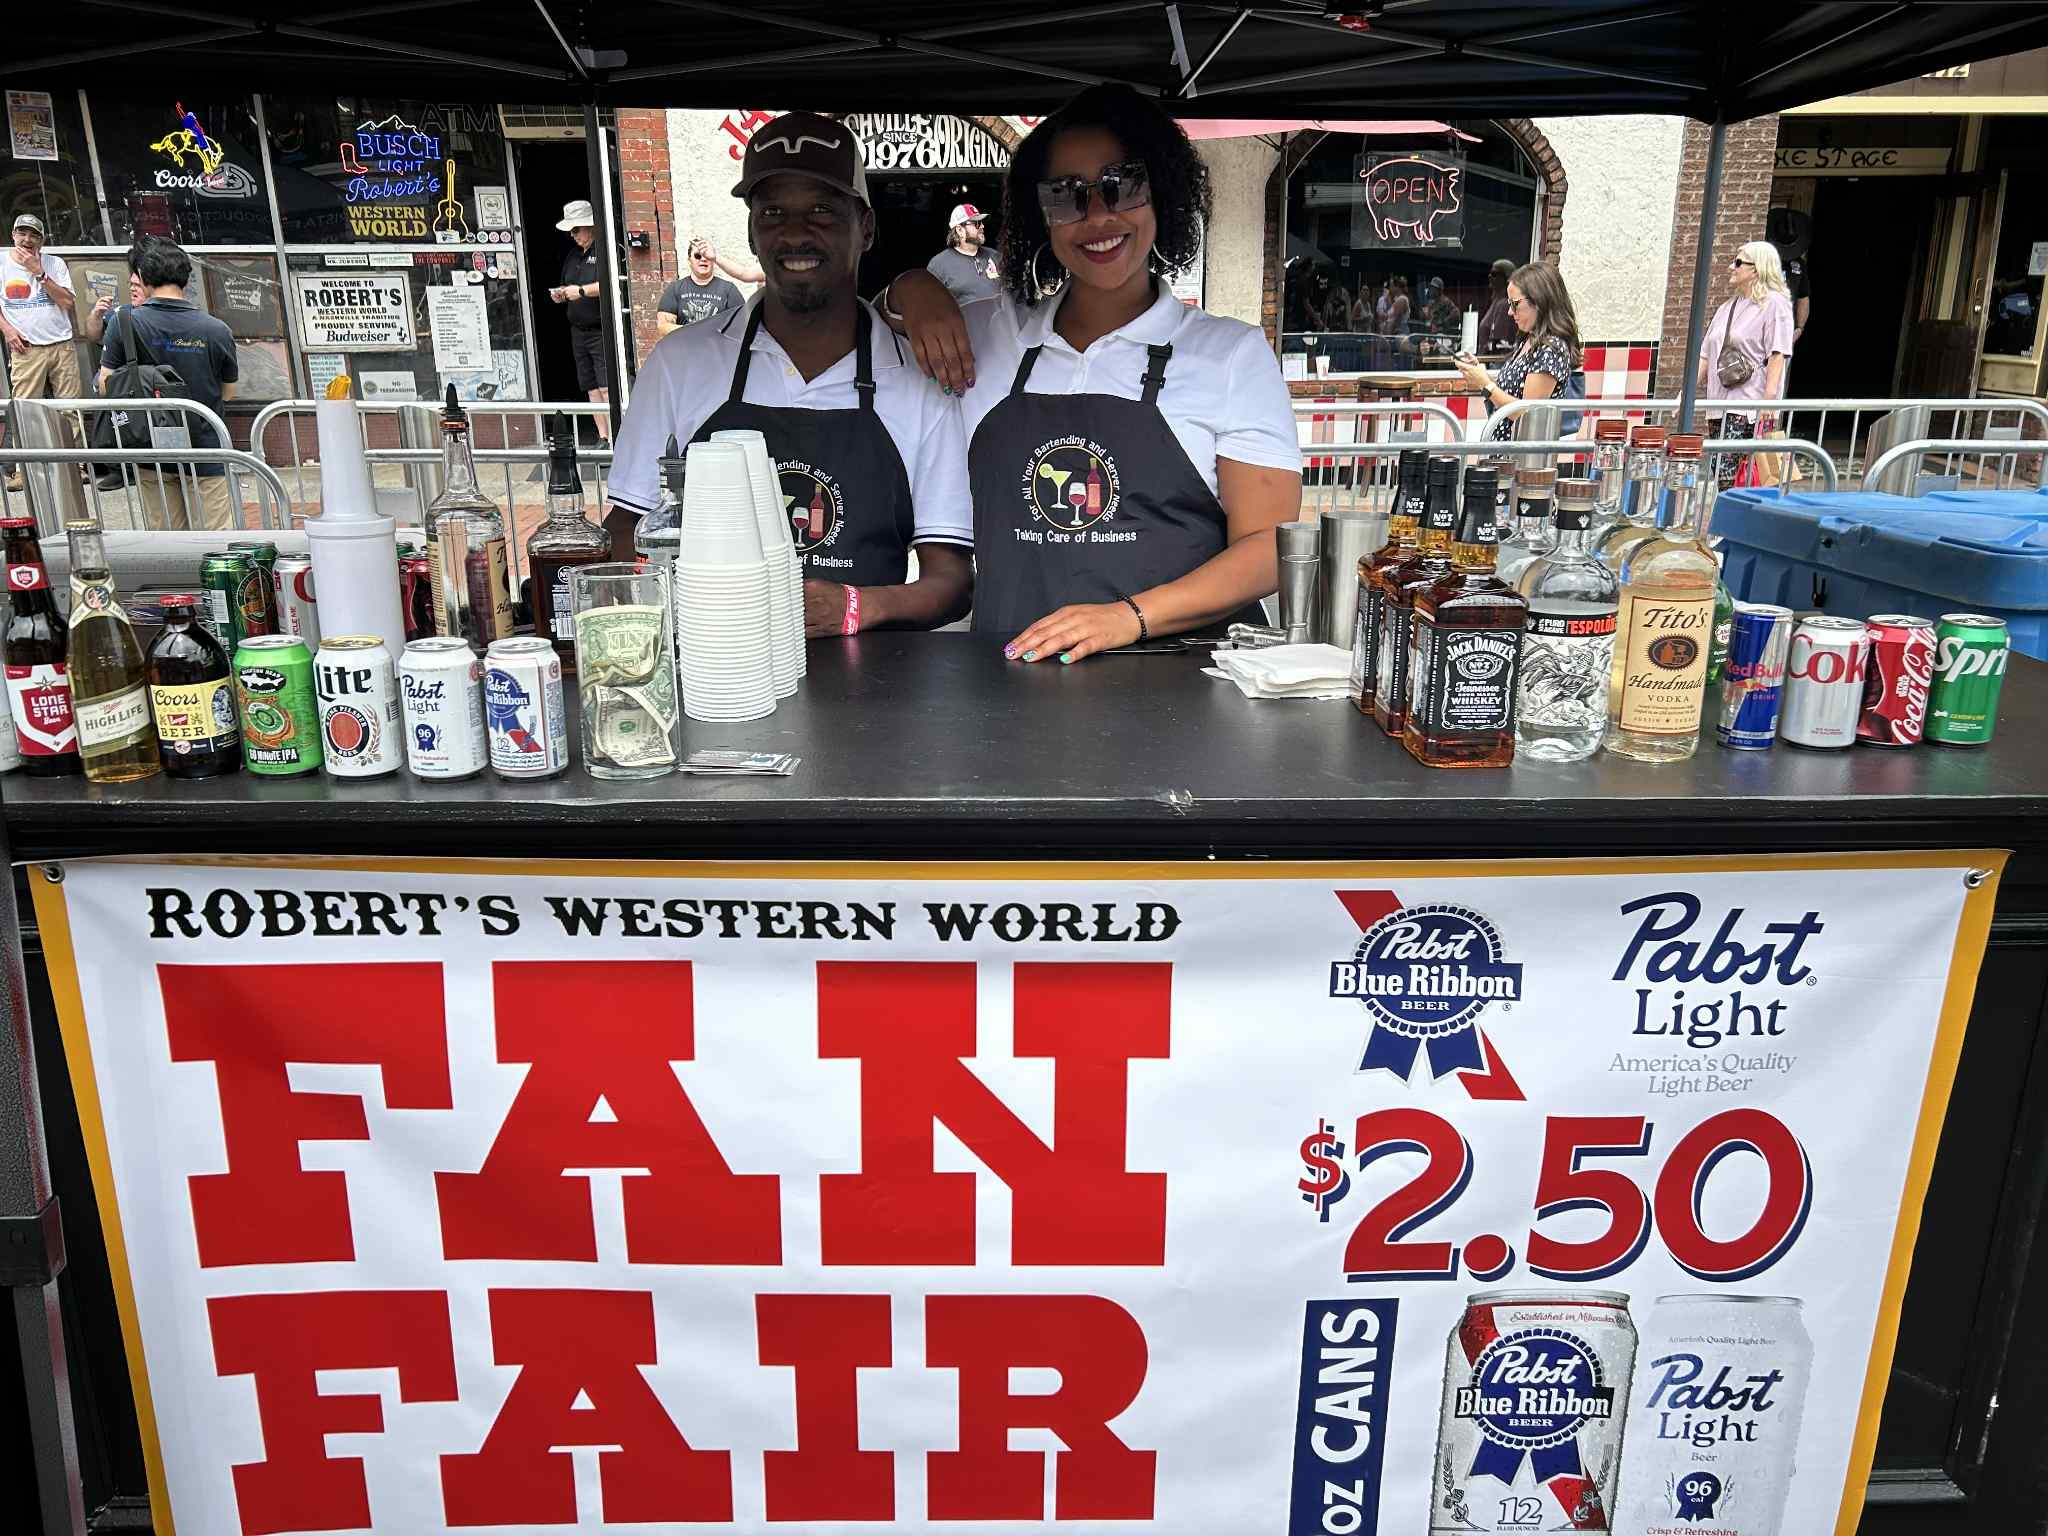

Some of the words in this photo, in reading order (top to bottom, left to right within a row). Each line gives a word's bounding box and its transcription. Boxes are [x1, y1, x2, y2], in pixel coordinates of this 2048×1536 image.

[418, 103, 497, 133] ATM
[357, 133, 441, 160] BUSCH
[882, 131, 918, 143] SINCE
[864, 139, 938, 170] 1976
[1815, 148, 1898, 168] STAGE
[378, 160, 425, 172] LIGHT
[154, 169, 204, 188] Coors
[345, 171, 441, 202] Robert's
[1373, 177, 1444, 204] OPEN
[347, 205, 426, 219] WESTERN
[350, 219, 428, 237] WORLD
[321, 280, 361, 288] WELCOME
[303, 288, 403, 307] ROBERT'S
[317, 307, 357, 315] WESTERN
[359, 306, 387, 314] WORLD
[326, 330, 390, 342] Budweiser
[1034, 435, 1087, 458] Bartending
[1088, 440, 1107, 457] and
[777, 460, 811, 473] ending
[813, 468, 833, 484] and
[1022, 458, 1036, 486] Your
[1105, 456, 1120, 491] Server
[830, 483, 845, 516] Server
[1022, 485, 1033, 500] All
[1028, 504, 1043, 522] For
[1102, 494, 1121, 523] Needs
[824, 519, 845, 548] Needs
[1014, 529, 1043, 544] Taking
[1047, 530, 1071, 543] Care
[1075, 532, 1087, 543] of
[1091, 530, 1137, 543] Business
[812, 554, 853, 568] Business
[1544, 618, 1566, 627] PURO
[1641, 606, 1709, 629] Tito's
[1446, 640, 1474, 661] JACK
[1474, 636, 1516, 661] DANIEL'S
[1788, 633, 1867, 684] Cok
[1727, 657, 1753, 677] Red
[1754, 662, 1783, 678] Bull
[1933, 636, 2011, 683] Spri
[315, 663, 373, 702] Lite
[402, 674, 446, 699] Pabst
[486, 675, 511, 693] Pabst
[1455, 681, 1500, 693] Tennessee
[31, 694, 65, 707] LONE
[153, 689, 200, 706] Coors
[407, 699, 441, 715] Light
[494, 693, 529, 706] Ribbon
[1450, 696, 1503, 705] WHISKEY
[1647, 695, 1690, 703] VODKA
[33, 704, 70, 718] STAR
[85, 714, 116, 731] HIGH
[119, 703, 143, 721] LIFE
[339, 706, 368, 728] PILSNER
[160, 727, 206, 737] BEER
[417, 728, 432, 738] 96
[281, 748, 298, 760] IPA
[145, 887, 521, 939] ROBERT'S
[544, 897, 896, 941] WESTERN
[923, 902, 1183, 942] WORLD
[1379, 921, 1478, 961] Pabst
[1611, 891, 1825, 986] Pabst
[1333, 963, 1404, 996] Blue
[1407, 964, 1516, 998] Ribbon
[1401, 1000, 1450, 1011] BEER
[1632, 988, 1788, 1049] Light
[1608, 1053, 1718, 1073] America's
[1720, 1052, 1798, 1074] Quality
[1648, 1075, 1702, 1097] Light
[1704, 1075, 1753, 1093] Beer
[156, 960, 1173, 1269] FAN
[1298, 1107, 1814, 1282] $2.50
[1510, 1311, 1564, 1324] Established
[1706, 1335, 1737, 1345] Quality
[1738, 1336, 1758, 1346] Light
[1759, 1337, 1777, 1345] Beer
[1491, 1345, 1583, 1384] Pabst
[1310, 1307, 1381, 1464] CANS
[1646, 1353, 1785, 1413] Pabst
[206, 1287, 1157, 1536] FAIR
[1457, 1386, 1511, 1416] Blue
[1516, 1386, 1610, 1417] Ribbon
[1508, 1418, 1554, 1427] BEER
[1656, 1412, 1759, 1448] Light
[1691, 1452, 1717, 1462] Beer
[1685, 1480, 1713, 1496] 96
[1498, 1496, 1543, 1525] 12
[1646, 1527, 1671, 1536] Crisp
[1674, 1527, 1683, 1535] &
[1685, 1527, 1739, 1536] Refreshing
